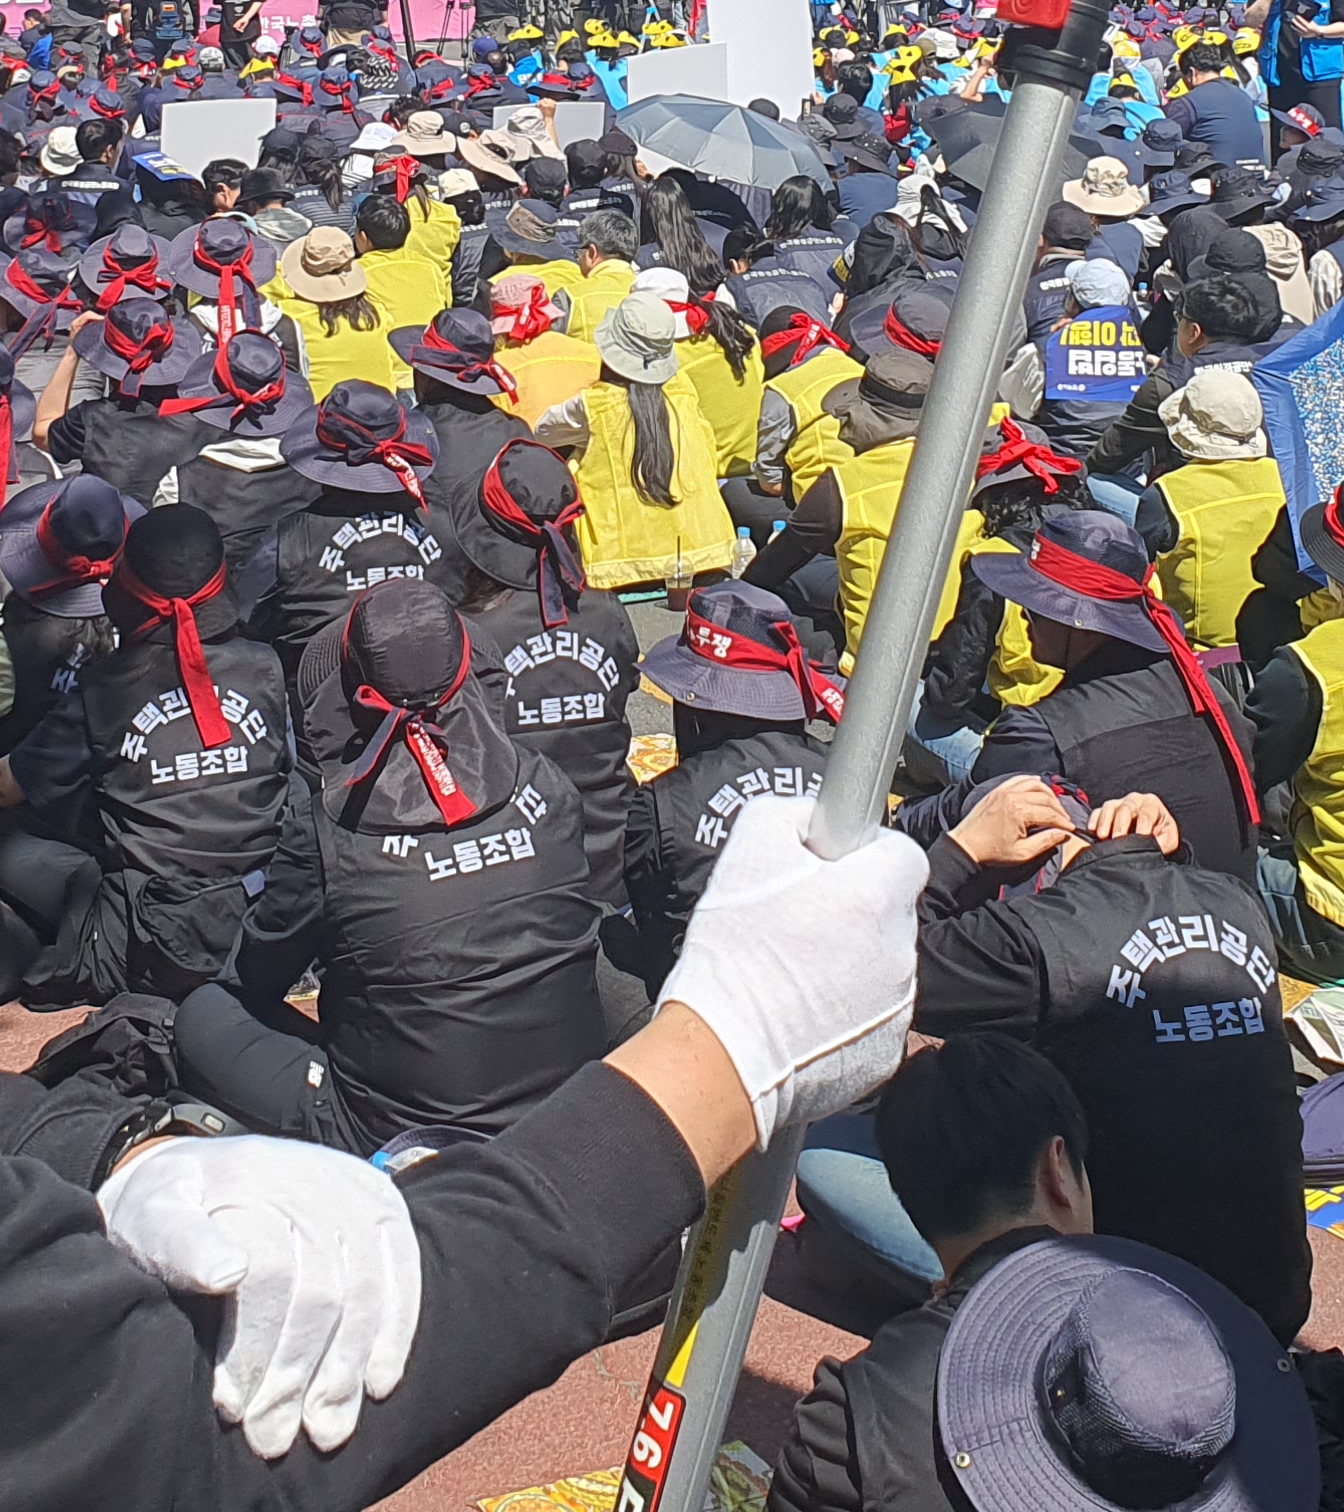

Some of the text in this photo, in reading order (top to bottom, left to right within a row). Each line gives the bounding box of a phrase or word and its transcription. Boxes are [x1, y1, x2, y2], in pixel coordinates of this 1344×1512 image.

[318, 510, 443, 573] 주택관리공단
[696, 627, 733, 658] 투쟁
[119, 685, 269, 764] 주택관공단
[517, 691, 605, 726] 노동조합
[150, 744, 249, 785] 노동조합
[424, 827, 536, 882] 노동조합
[1105, 913, 1276, 1009] 주택관리공단
[1152, 996, 1266, 1044] 노동조합
